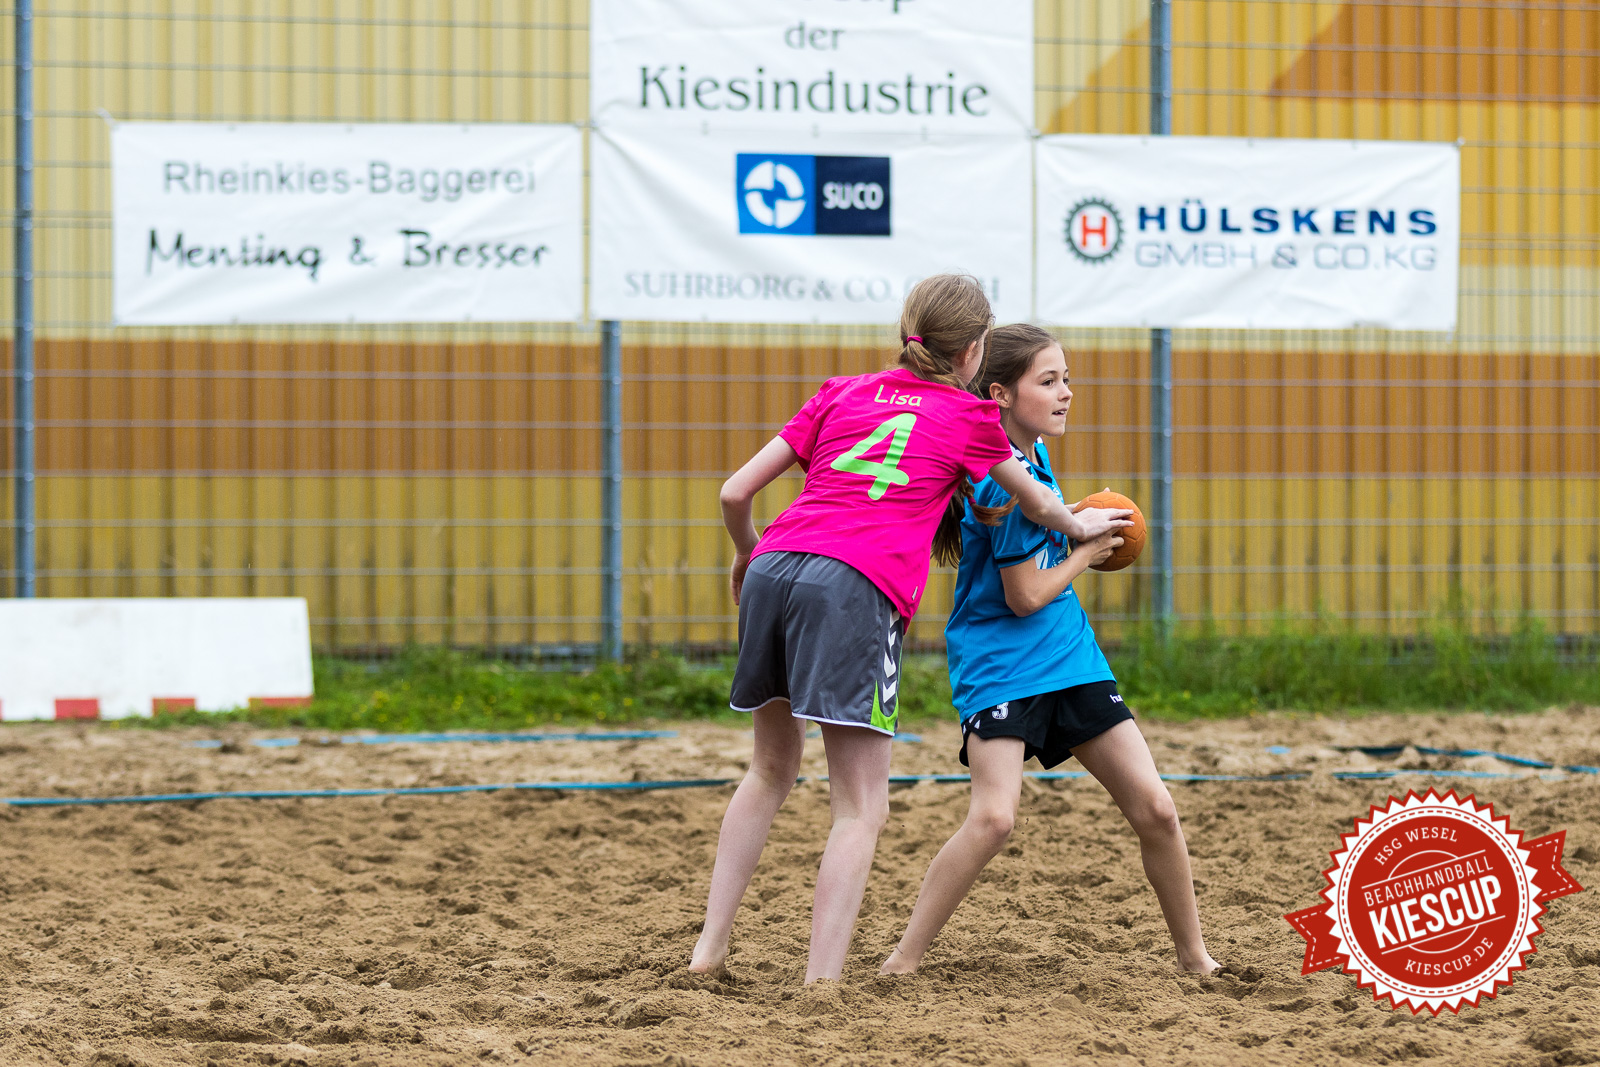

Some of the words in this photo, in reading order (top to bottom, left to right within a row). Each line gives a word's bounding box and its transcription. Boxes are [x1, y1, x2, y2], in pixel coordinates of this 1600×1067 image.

[784, 21, 846, 51] der
[638, 65, 991, 117] Kiesindustrie
[163, 160, 537, 202] Rheinkies-Baggerei
[822, 182, 884, 211] SUCO
[1138, 199, 1437, 235] HÜLSKENS
[146, 227, 325, 282] Menting
[347, 236, 376, 266] &
[399, 228, 551, 269] Bresser
[1135, 242, 1258, 270] GMBH
[1271, 245, 1298, 270] &
[1313, 244, 1437, 272] CO.KG
[623, 271, 806, 301] SUHRBORG
[812, 279, 833, 301] &
[874, 384, 922, 407] Lisa
[830, 412, 917, 501] 4
